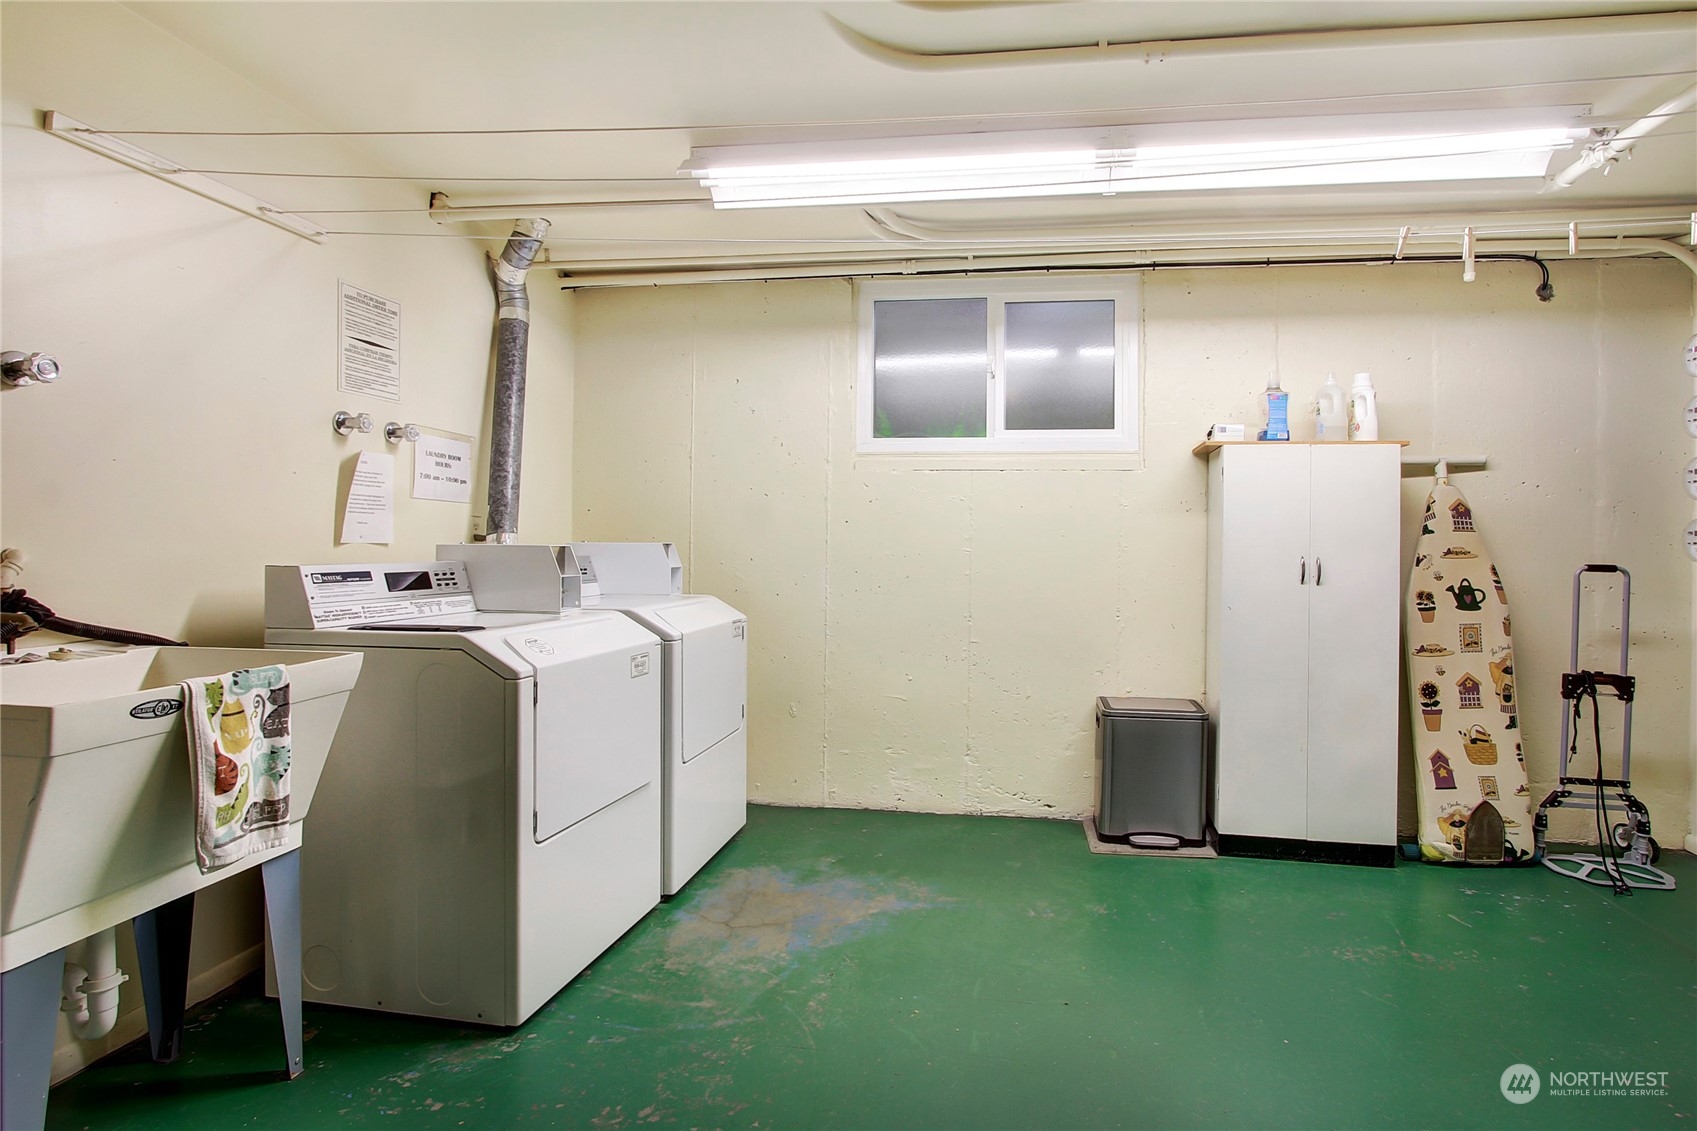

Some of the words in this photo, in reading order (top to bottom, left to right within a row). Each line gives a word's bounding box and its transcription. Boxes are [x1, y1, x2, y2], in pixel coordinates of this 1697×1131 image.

[425, 450, 447, 459] LAUNDRY
[447, 454, 462, 462] ROOM
[419, 472, 431, 480] 7:00
[445, 476, 459, 484] 10:00
